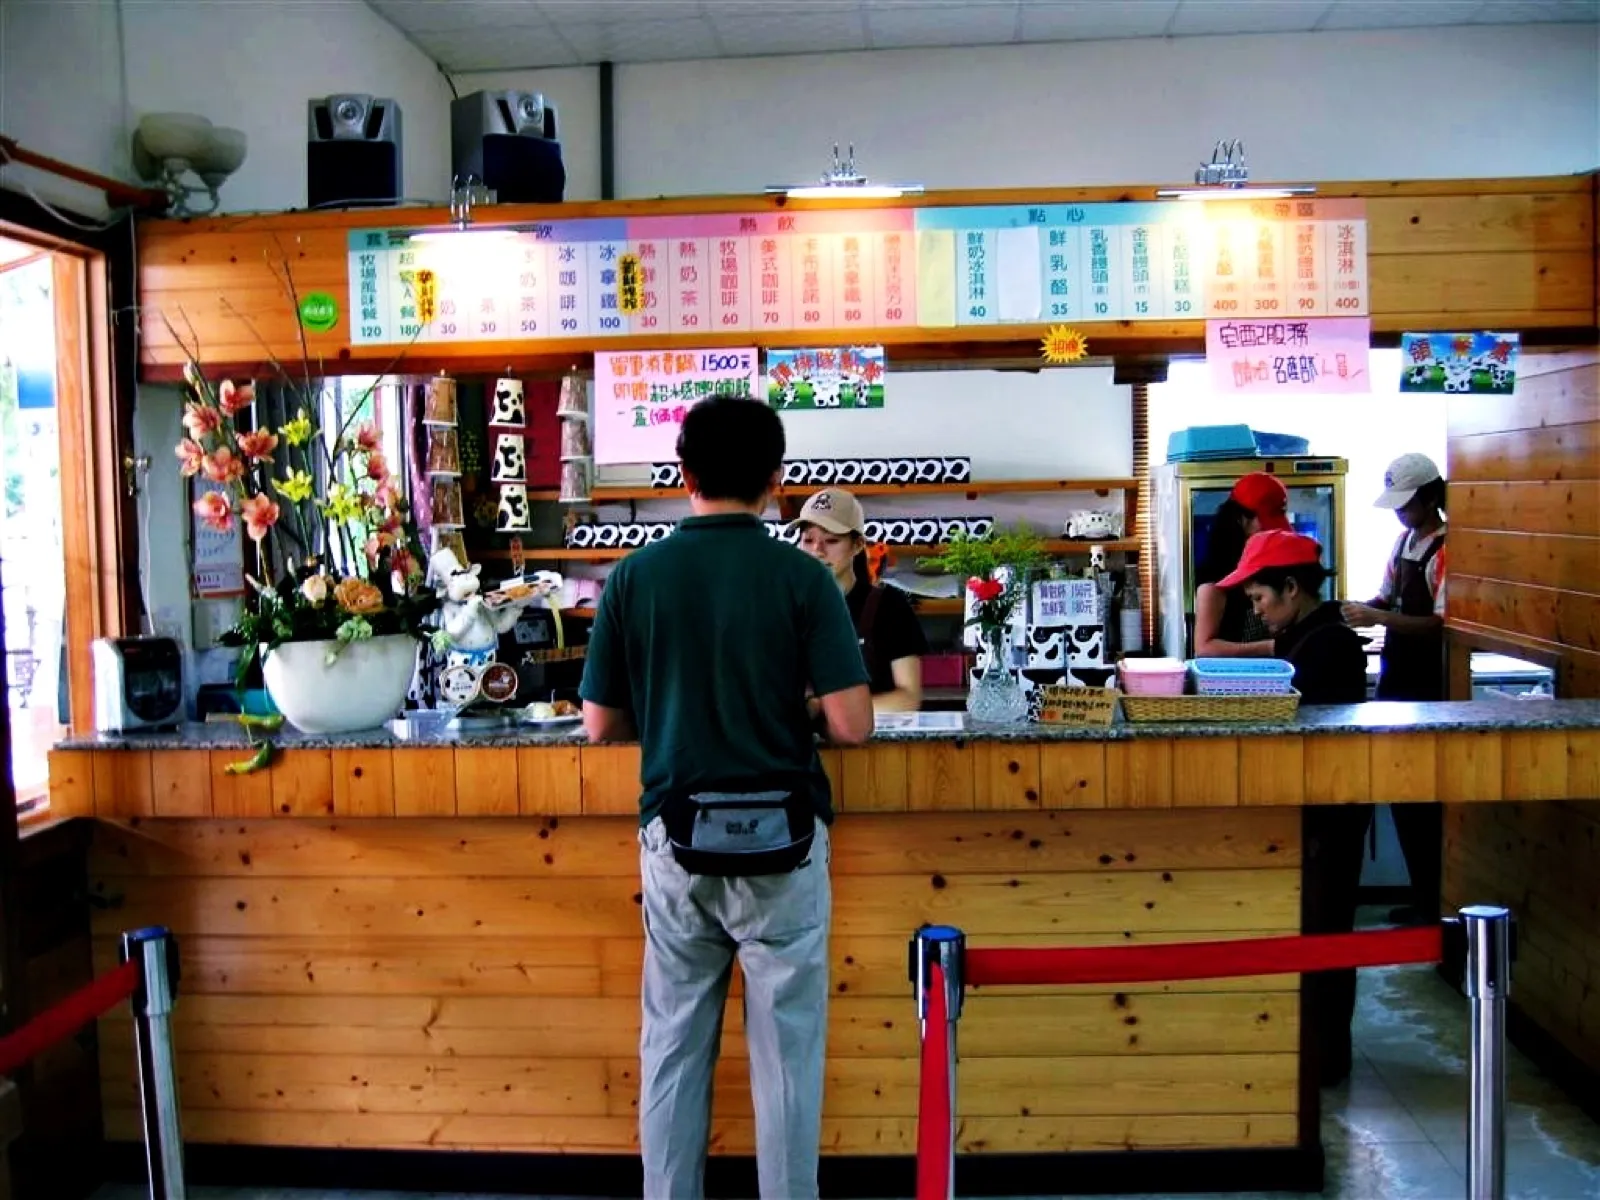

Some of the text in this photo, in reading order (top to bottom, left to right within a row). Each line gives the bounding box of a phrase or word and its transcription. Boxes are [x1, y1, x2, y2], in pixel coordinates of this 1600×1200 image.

[1028, 207, 1084, 222] 點心
[740, 216, 795, 232] 熱飲
[1337, 224, 1355, 274] 冰淇淋
[559, 245, 576, 311] 冰咖啡
[600, 244, 617, 309] 冰拿鐵
[679, 242, 698, 306] 熱奶茶
[720, 240, 738, 306] 牧場咖啡
[1051, 303, 1068, 315] 35
[1094, 302, 1108, 313] 10
[1135, 301, 1148, 313] 15
[1174, 300, 1191, 312] 30
[1213, 299, 1238, 310] 400
[1254, 299, 1279, 310] 300
[1298, 298, 1315, 309] 90
[1335, 297, 1360, 309] 400
[969, 305, 986, 317] 40
[599, 317, 620, 328] 100
[641, 315, 657, 328] 30
[682, 313, 698, 326] 50
[722, 313, 738, 325] 60
[763, 312, 779, 323] 70
[400, 324, 420, 336] 180
[441, 323, 456, 334] 30
[480, 321, 496, 333] 30
[521, 320, 537, 331] 50
[561, 318, 577, 330] 90
[361, 326, 381, 337] 120
